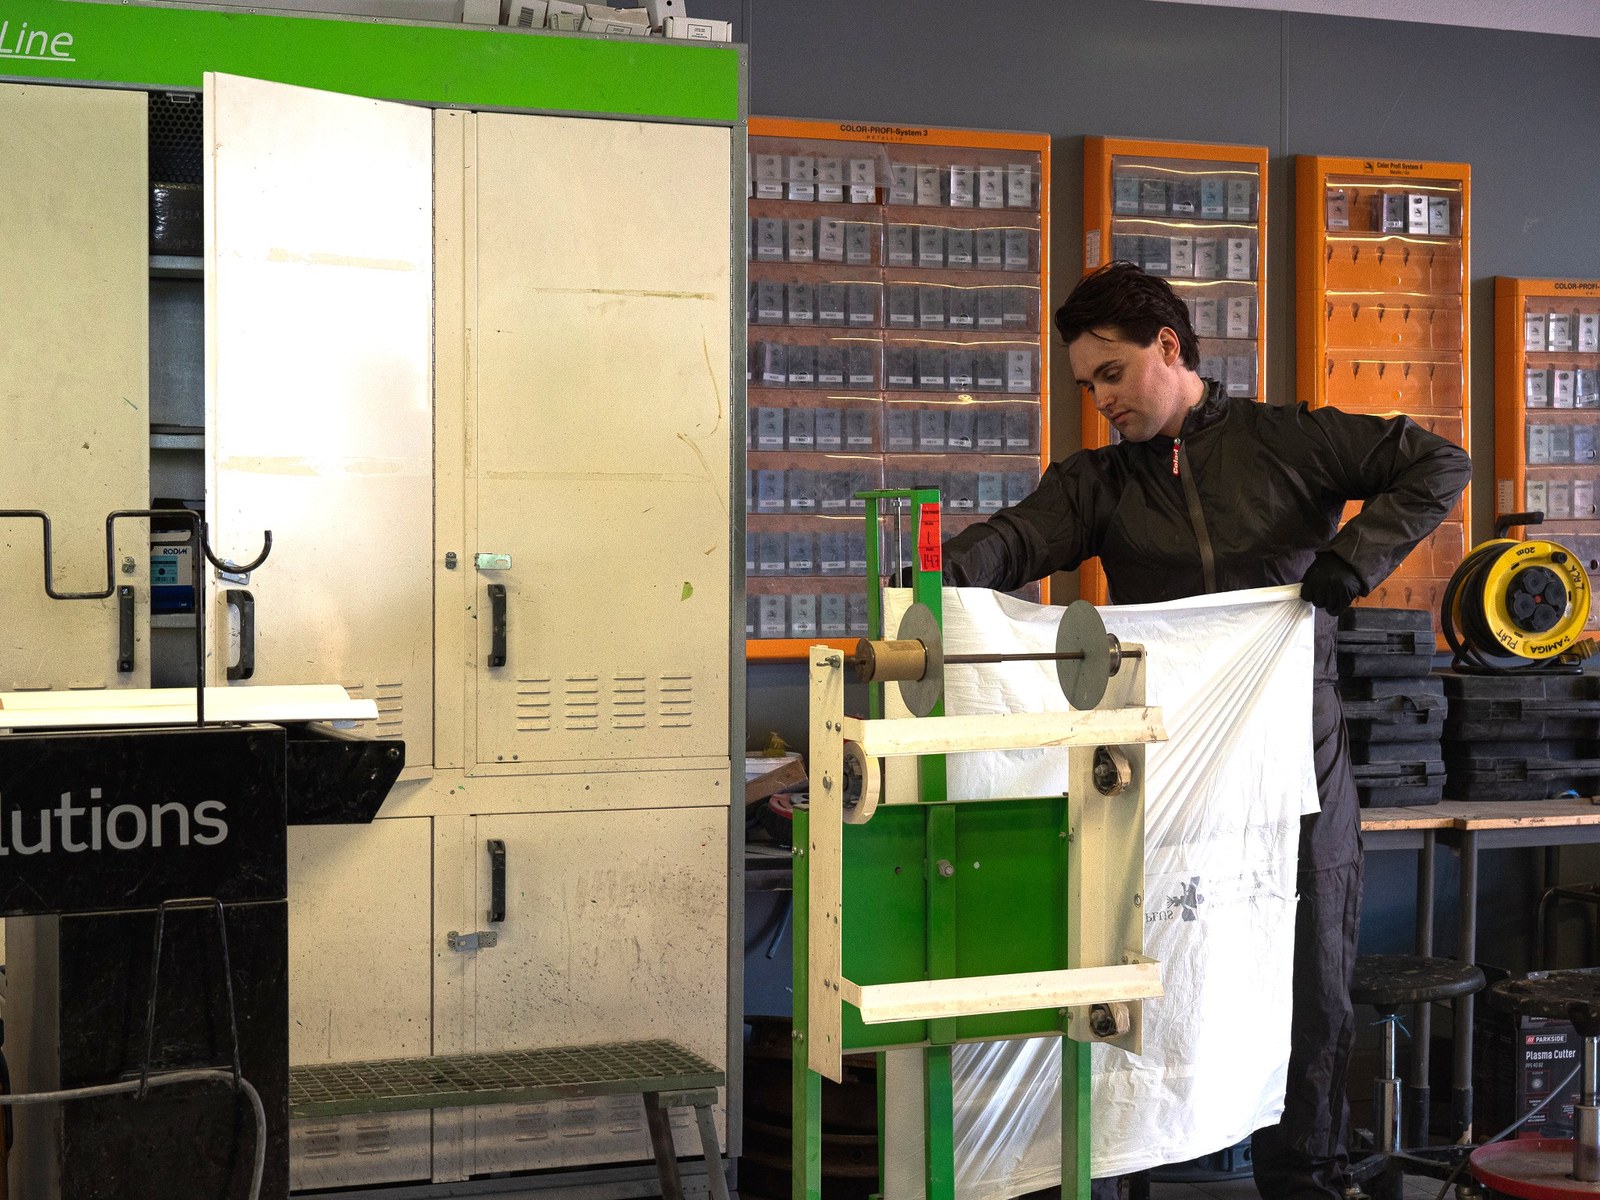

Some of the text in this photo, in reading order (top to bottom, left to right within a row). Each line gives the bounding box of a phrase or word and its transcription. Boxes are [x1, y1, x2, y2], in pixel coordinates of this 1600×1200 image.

[0, 20, 74, 57] Line
[840, 125, 921, 137] COLOR-PROFI-System
[1516, 547, 1535, 556] 20m
[924, 553, 939, 569] 147
[1531, 639, 1563, 654] AMIGA
[1526, 1050, 1576, 1060] Plasma Cutter
